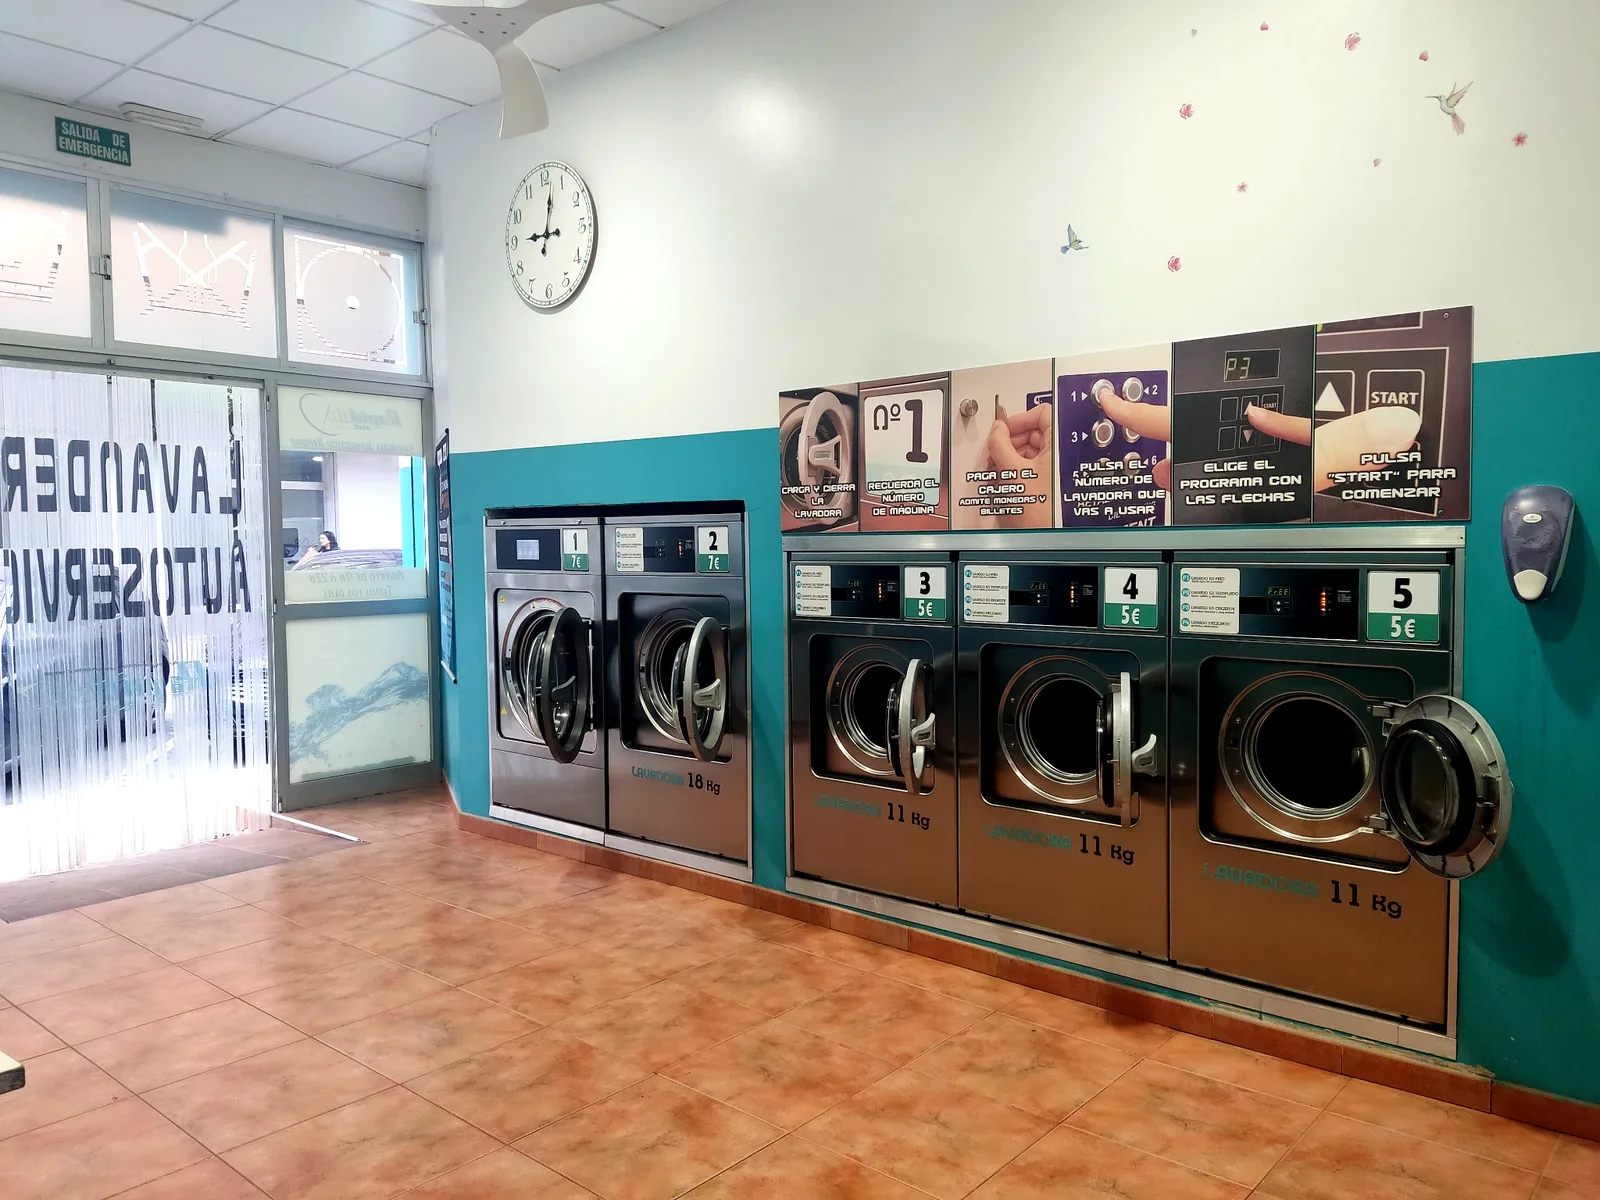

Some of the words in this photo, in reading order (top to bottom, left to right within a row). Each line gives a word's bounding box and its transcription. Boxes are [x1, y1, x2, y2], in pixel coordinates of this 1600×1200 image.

[61, 121, 100, 142] SALIDA
[112, 133, 126, 148] DE
[58, 136, 129, 164] EMERGENCIA
[540, 169, 550, 187] 12
[560, 175, 565, 190] 1
[525, 184, 533, 200] 11
[572, 191, 580, 208] 2
[513, 209, 522, 224] 10
[578, 217, 586, 234] 3
[511, 235, 518, 251] 9
[573, 246, 582, 264] 4
[516, 261, 524, 275] 8
[528, 278, 536, 294] 7
[561, 272, 570, 287] 5
[545, 283, 553, 299] 6
[1225, 357, 1251, 380] P3
[1071, 391, 1077, 402] 1
[1152, 385, 1158, 395] 2
[1371, 392, 1419, 405] START
[904, 399, 928, 463] 1
[1071, 432, 1078, 443] 3
[1080, 461, 1124, 471] PULSA
[1129, 459, 1147, 470] EL
[1151, 455, 1157, 465] 6
[1361, 451, 1421, 465] PULSA
[1204, 461, 1248, 472] ELIGE
[1254, 460, 1275, 470] EL
[967, 471, 997, 481] PAGA
[1001, 470, 1017, 479] EN
[1021, 470, 1037, 478] EL
[1075, 475, 1129, 487] NÚMERO
[1134, 475, 1153, 484] DE
[1407, 468, 1457, 480] PARA
[782, 485, 810, 495] CARGA
[813, 484, 819, 493] Y
[823, 483, 856, 493] CIERRA
[868, 480, 921, 490] RECUERDA
[925, 478, 939, 487] EL
[979, 484, 1025, 494] CAJERO
[1180, 476, 1263, 489] PROGRAMA
[1269, 475, 1302, 486] CON
[882, 491, 924, 502] NÚMERO
[959, 498, 991, 506] ADMITE
[994, 496, 1036, 504] MONEDAS
[1039, 495, 1046, 503] Y
[1064, 490, 1132, 502] LAVADORA
[1138, 489, 1166, 499] QUE
[1185, 495, 1215, 505] LAS
[1221, 492, 1295, 504] FLECHAS
[1342, 486, 1441, 500] COMENZAR
[812, 497, 824, 505] LA
[794, 510, 842, 518] LAVADORA
[873, 507, 886, 516] DE
[890, 505, 934, 515] MÁQUINA
[980, 507, 1023, 515] BILLETES
[1073, 507, 1099, 516] VAS
[1104, 506, 1113, 515] A
[1118, 505, 1155, 515] USAR
[572, 532, 578, 551] 1
[708, 531, 718, 551] 2
[571, 554, 581, 568] 7€
[708, 555, 719, 570] 7€
[919, 571, 931, 595] 3
[1122, 572, 1138, 600] 4
[1393, 577, 1413, 609] 5
[918, 600, 933, 617] 5€
[1121, 605, 1140, 625] 5€
[1390, 615, 1416, 638] 5€
[688, 772, 704, 789] 18
[706, 779, 721, 795] Kg
[887, 802, 905, 823] 11
[911, 812, 930, 830] Kg
[1079, 833, 1102, 857] 11
[1110, 844, 1135, 865] Kg
[1330, 880, 1359, 907] 11
[1371, 894, 1403, 919] Kg
